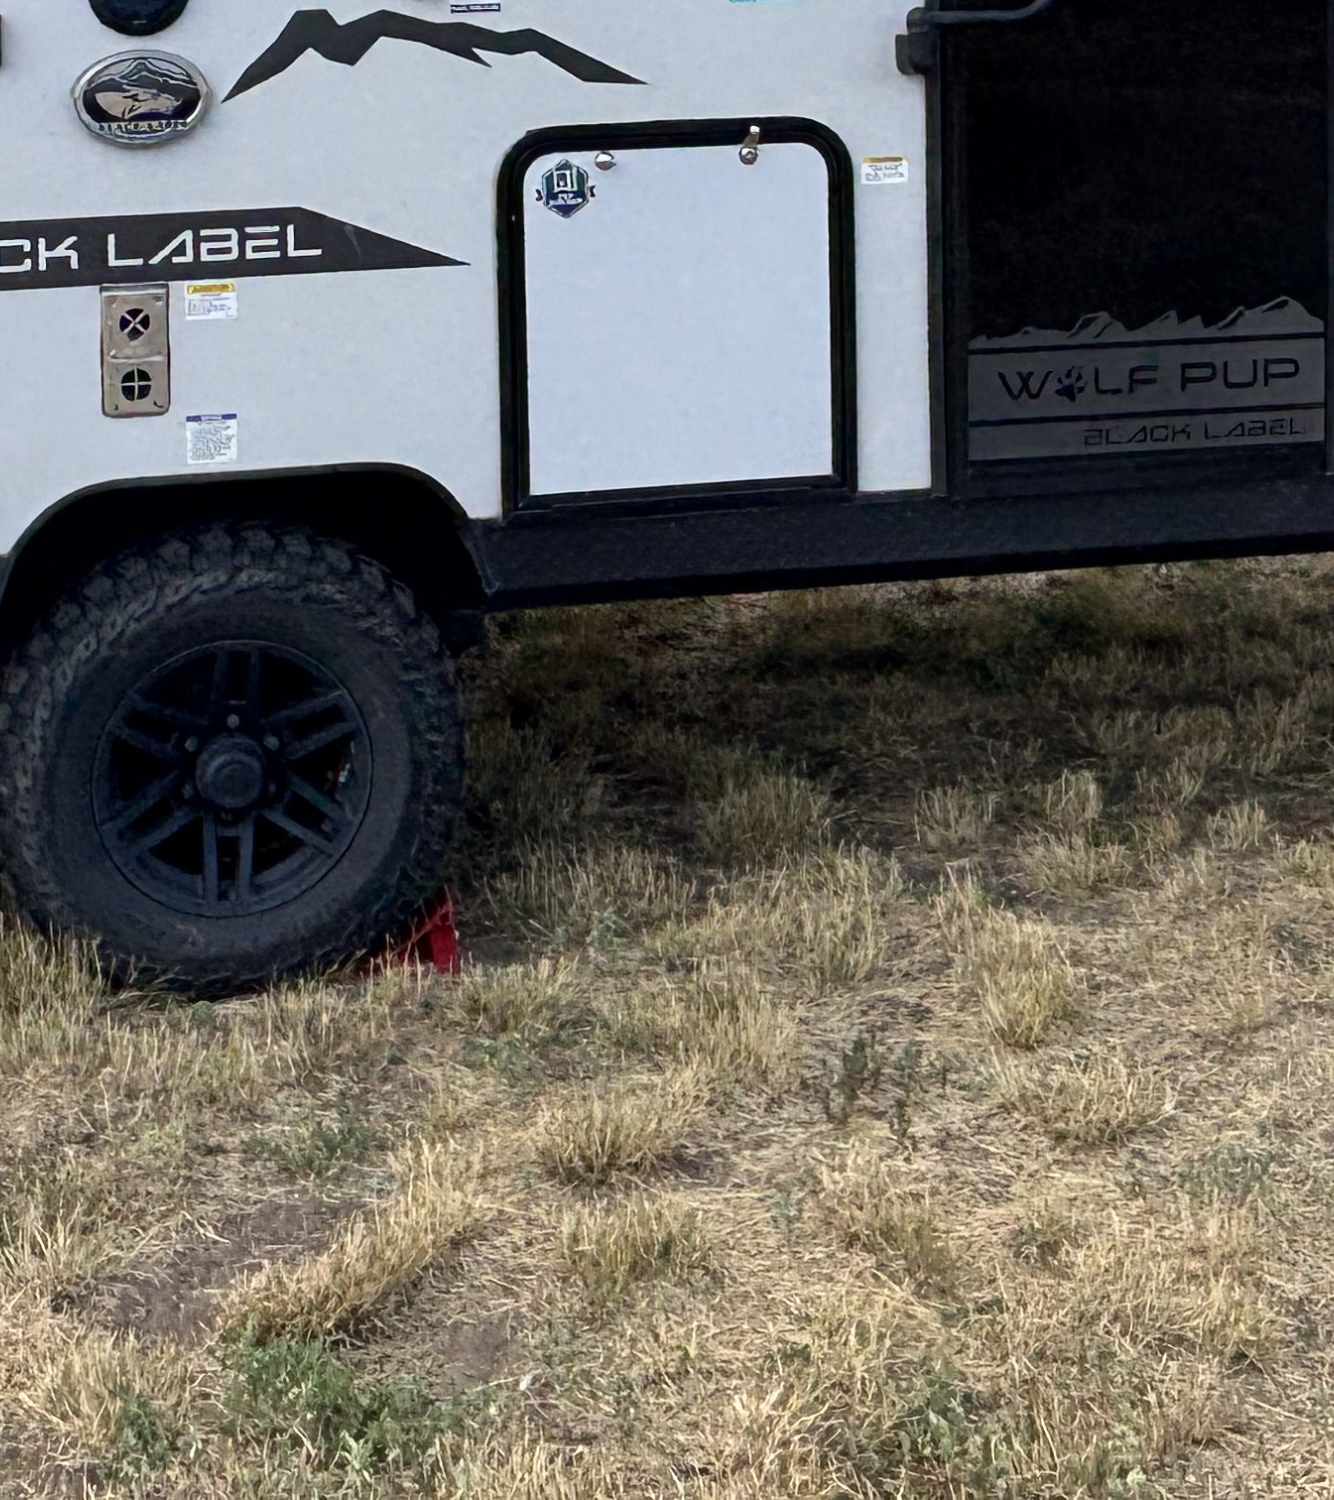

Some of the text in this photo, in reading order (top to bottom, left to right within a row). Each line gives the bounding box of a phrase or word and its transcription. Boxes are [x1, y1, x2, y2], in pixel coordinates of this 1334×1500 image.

[107, 224, 323, 268] LABEL
[1180, 358, 1300, 392] PUP
[1083, 417, 1305, 446] BLACK LABEL
